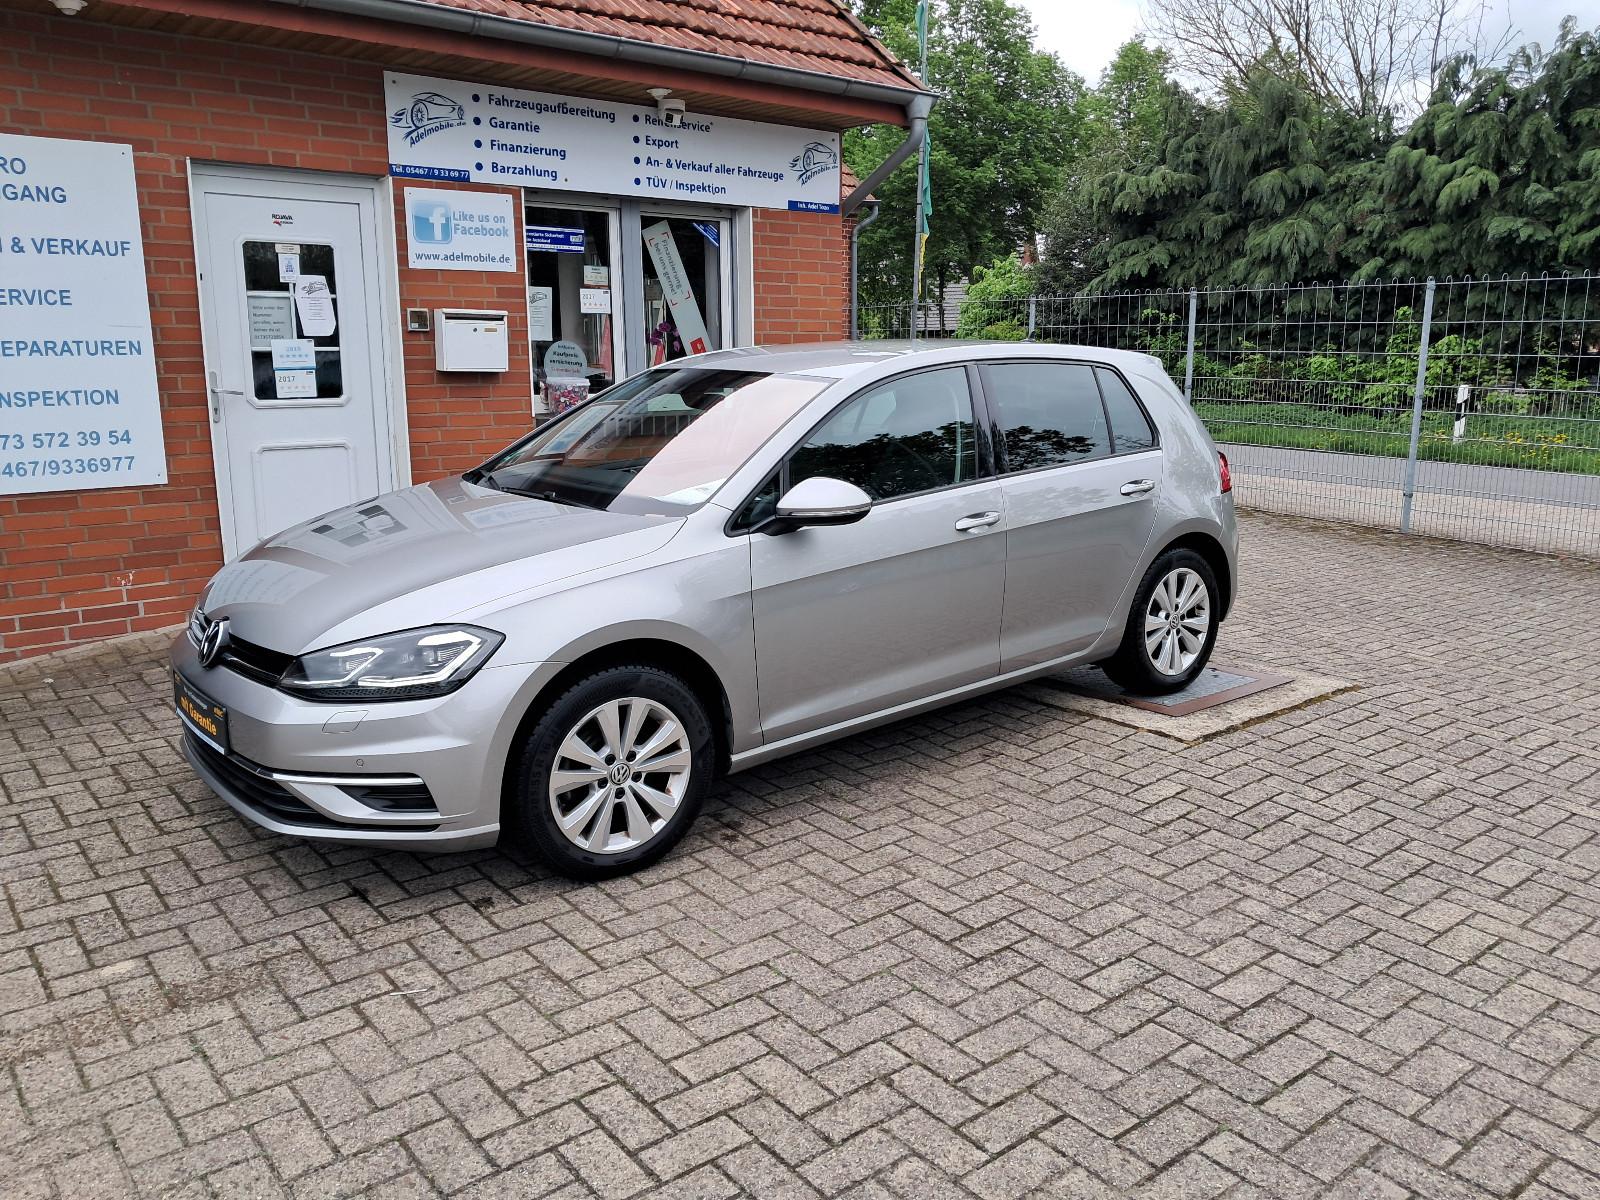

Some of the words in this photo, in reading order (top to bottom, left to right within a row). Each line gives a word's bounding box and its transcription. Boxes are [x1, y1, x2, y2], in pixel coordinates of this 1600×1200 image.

[488, 94, 616, 123] Fahrzeugaufbereitung
[489, 117, 540, 133] Garantie
[490, 139, 566, 160] Finanzierung
[645, 135, 679, 149] Export
[392, 165, 404, 173] Tel.
[406, 166, 428, 175] 05467
[440, 169, 449, 177] 33
[460, 171, 469, 179] 77
[491, 162, 558, 181] Barzahlung
[645, 156, 663, 168] An-
[666, 158, 673, 169] &
[675, 159, 712, 173] Verkauf
[714, 164, 736, 176] aller
[737, 166, 784, 181] Fahrzeuge
[2, 183, 67, 203] GANG
[646, 176, 667, 189] TÜV
[669, 179, 674, 190] /
[675, 179, 726, 195] Inspektion
[453, 211, 475, 223] Like
[478, 213, 490, 223] us
[493, 214, 506, 224] on
[453, 224, 509, 238] Facebook
[11, 236, 26, 254] &
[31, 237, 131, 257] VERKAUF
[415, 251, 511, 264] www.adelmobile.de
[1, 340, 142, 357] EPARATUREN
[0, 389, 120, 408] NSPEKTION
[0, 434, 25, 450] 73
[32, 432, 70, 449] 572
[77, 430, 101, 447] 39
[108, 429, 132, 446] 54
[2, 456, 135, 478] 467/9336977
[189, 702, 217, 736] Garantie
